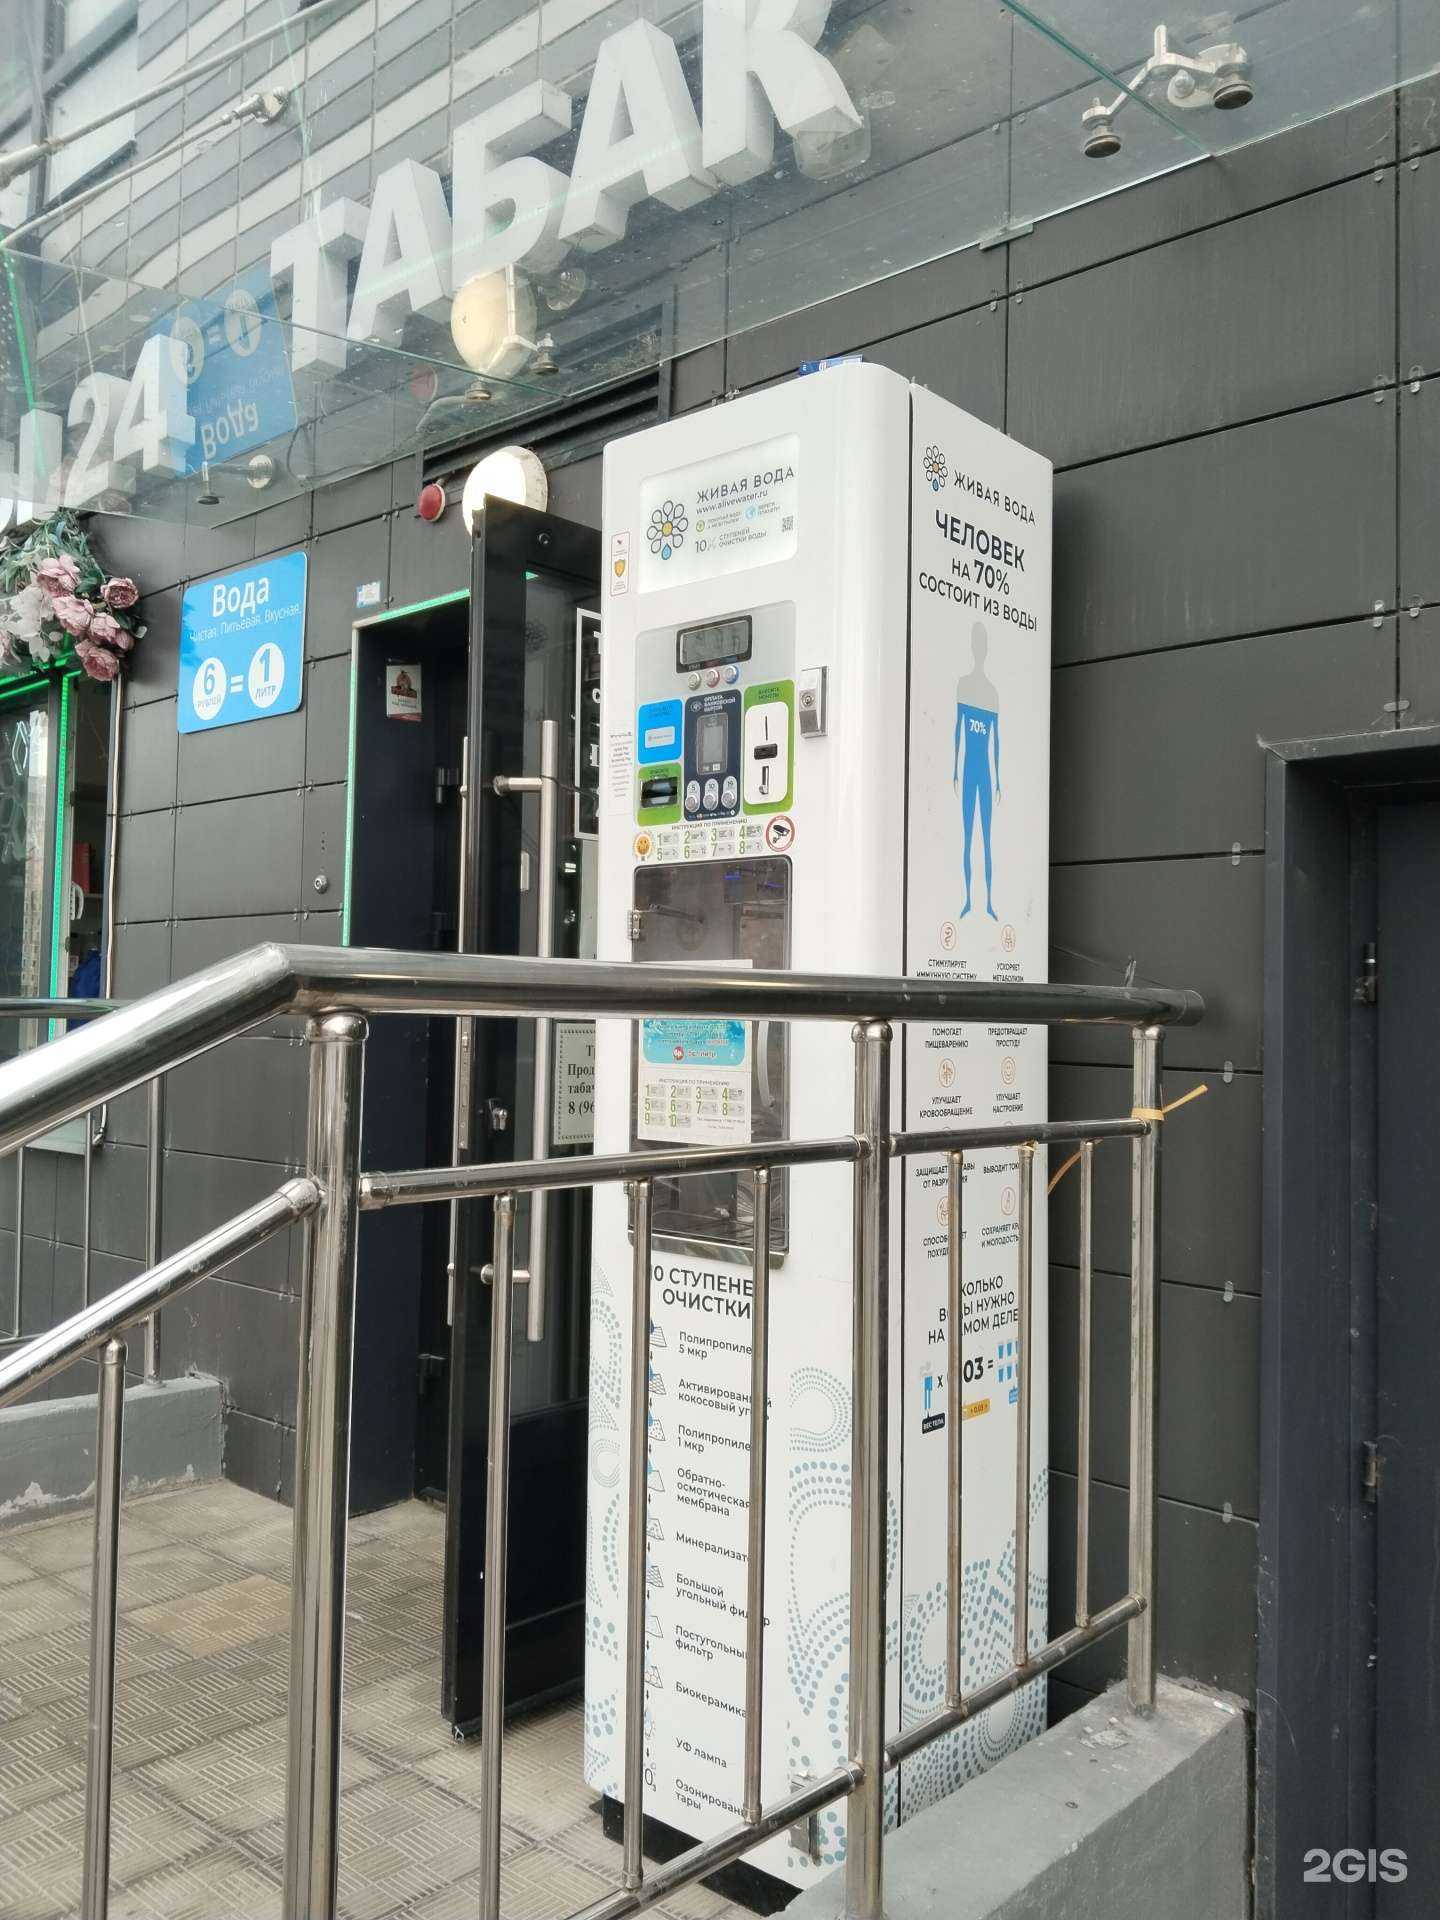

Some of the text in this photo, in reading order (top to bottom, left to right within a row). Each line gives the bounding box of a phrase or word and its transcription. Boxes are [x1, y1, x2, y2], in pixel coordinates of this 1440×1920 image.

[271, 0, 862, 375] ТАБАК
[64, 333, 196, 507] 24
[697, 466, 795, 503] ЖИВАЯ ВОДА
[696, 490, 768, 514] www.alivewater.ru
[954, 470, 1036, 526] ЖИВАЯ ВОДА
[695, 539, 707, 552] 10
[935, 509, 1025, 572] ЧЕЛОВЕК
[952, 558, 1010, 595] НА 70%
[212, 577, 270, 618] Вода
[919, 572, 1038, 631] СОСТОИТ ИЗ ВОДЫ
[203, 663, 216, 696] 6
[259, 648, 271, 683] 1
[255, 685, 276, 699] ЛИТР
[969, 718, 987, 735] 70%
[656, 833, 662, 846] 1
[684, 831, 690, 844] 2
[711, 828, 717, 842] 3
[738, 825, 746, 840] 4
[656, 848, 663, 861] 5
[684, 845, 690, 859] 6
[711, 843, 717, 857] 7
[738, 841, 746, 854] 8
[928, 959, 967, 969] СТИМУЛИРУЕТ
[932, 1028, 962, 1036] ПОМОГАЕТ
[988, 1027, 1028, 1036] ПРЕДОТВРАЩАЕТ
[925, 1040, 969, 1049] ПИЩЕВАРЕНИЮ
[645, 1084, 650, 1097] 1
[671, 1085, 677, 1098] 2
[696, 1087, 702, 1100] 3
[722, 1088, 728, 1101] 4
[932, 1095, 962, 1105] УЛУЧШАЕТ
[996, 1092, 1021, 1101] УЛУЧШАЕТ
[568, 1101, 575, 1115] 8
[645, 1098, 650, 1111] 5
[671, 1099, 676, 1112] 6
[696, 1101, 702, 1114] 7
[722, 1102, 728, 1116] 8
[919, 1107, 974, 1119] КРОВООБРАЩЕНИЕ
[993, 1104, 1024, 1113] НАСТРОЕНИЕ
[645, 1112, 677, 1127] 9 10
[915, 1165, 948, 1176] ЗАЩИЩАЕТ
[983, 1164, 1008, 1174] ВЫВОДИТ
[923, 1180, 931, 1189] ОТ
[981, 1223, 1011, 1236] СОХРАНЯЕТ
[981, 1241, 986, 1249] И
[670, 1268, 753, 1297] СТУПЕНЕ
[961, 1275, 1003, 1296] КОЛЬКО
[663, 1288, 751, 1319] ОЧИСТКИ
[976, 1291, 1015, 1313] НУЖНО
[928, 1328, 946, 1345] НА
[992, 1308, 1019, 1330] ДЕЛЕ
[679, 1331, 752, 1355] Полипропиле
[679, 1344, 708, 1360] 5 мкр
[678, 1393, 736, 1413] кокосовый
[678, 1424, 751, 1451] Полипропиле
[678, 1437, 705, 1454] 1 мкр
[677, 1468, 726, 1488] Обратно-
[677, 1495, 730, 1516] мембрана
[676, 1573, 724, 1597] Большой
[676, 1587, 727, 1611] угольный
[675, 1639, 714, 1661] фильтр
[676, 1625, 747, 1660] Постугольны
[676, 1737, 727, 1768] УФ лампа
[675, 1792, 701, 1810] тары
